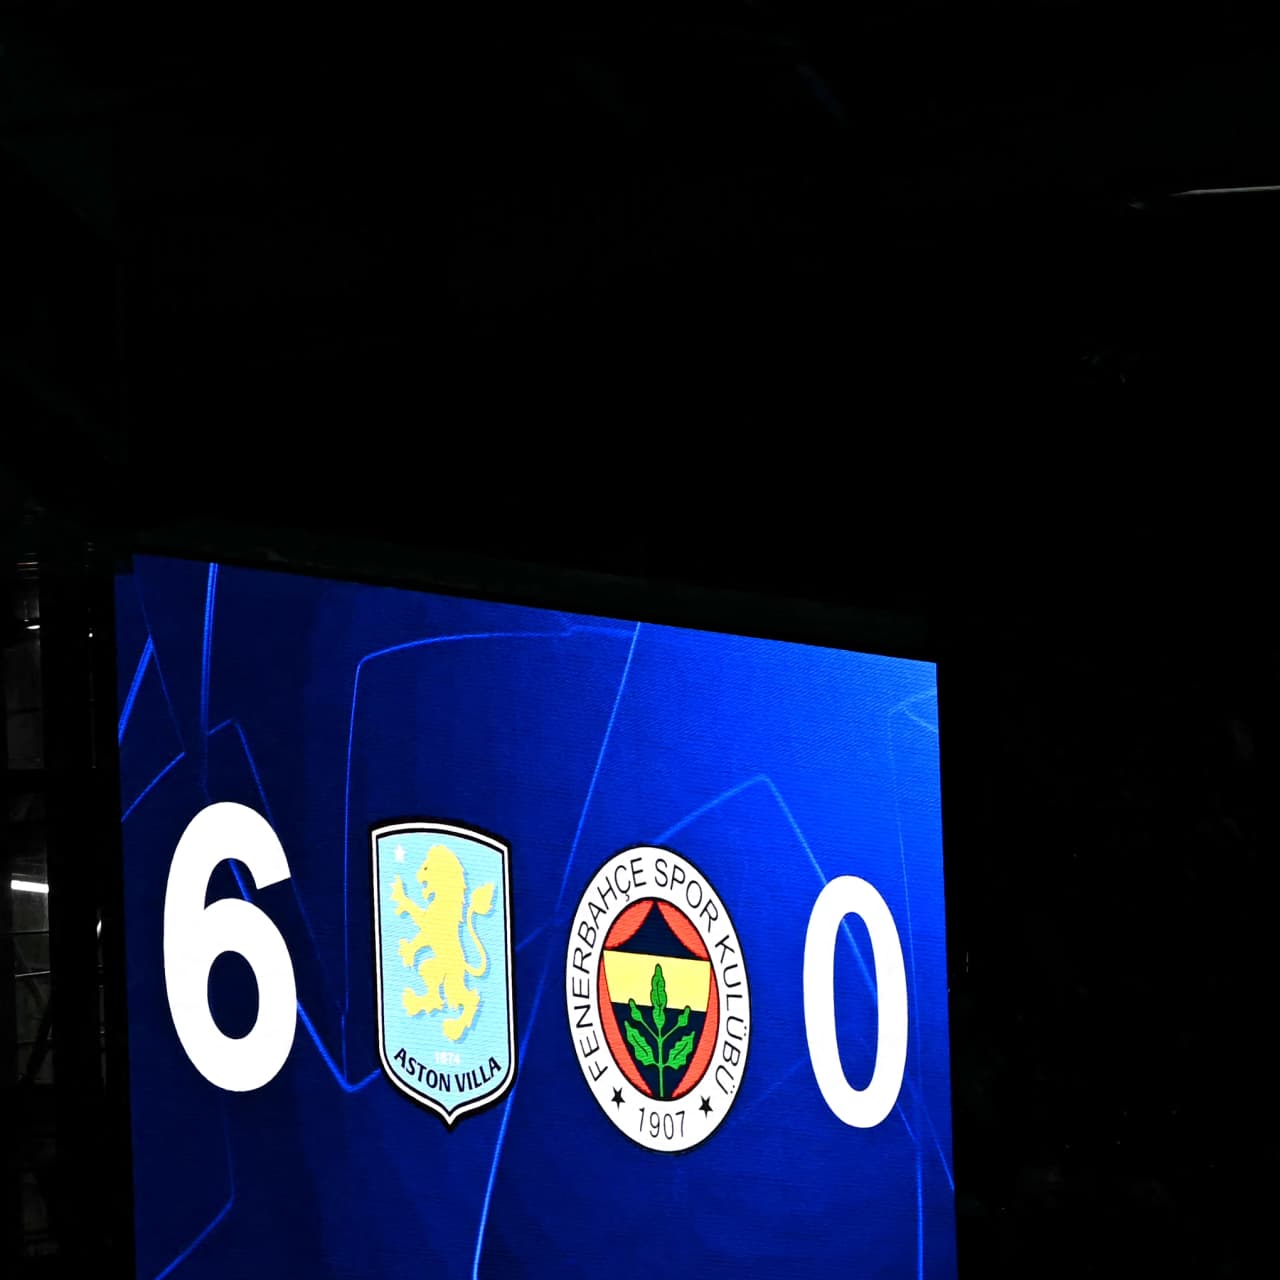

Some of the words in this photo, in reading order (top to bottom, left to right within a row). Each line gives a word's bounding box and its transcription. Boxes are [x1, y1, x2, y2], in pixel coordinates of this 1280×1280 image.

[163, 801, 299, 1093] 6
[573, 857, 646, 1082] FENERBAHÇE
[654, 858, 719, 932] SPOR
[715, 935, 747, 1096] KULÜBÜ
[802, 875, 909, 1129] 0
[394, 1048, 451, 1092] ASTON
[455, 1056, 501, 1092] VILLA
[638, 1107, 686, 1140] 1907
